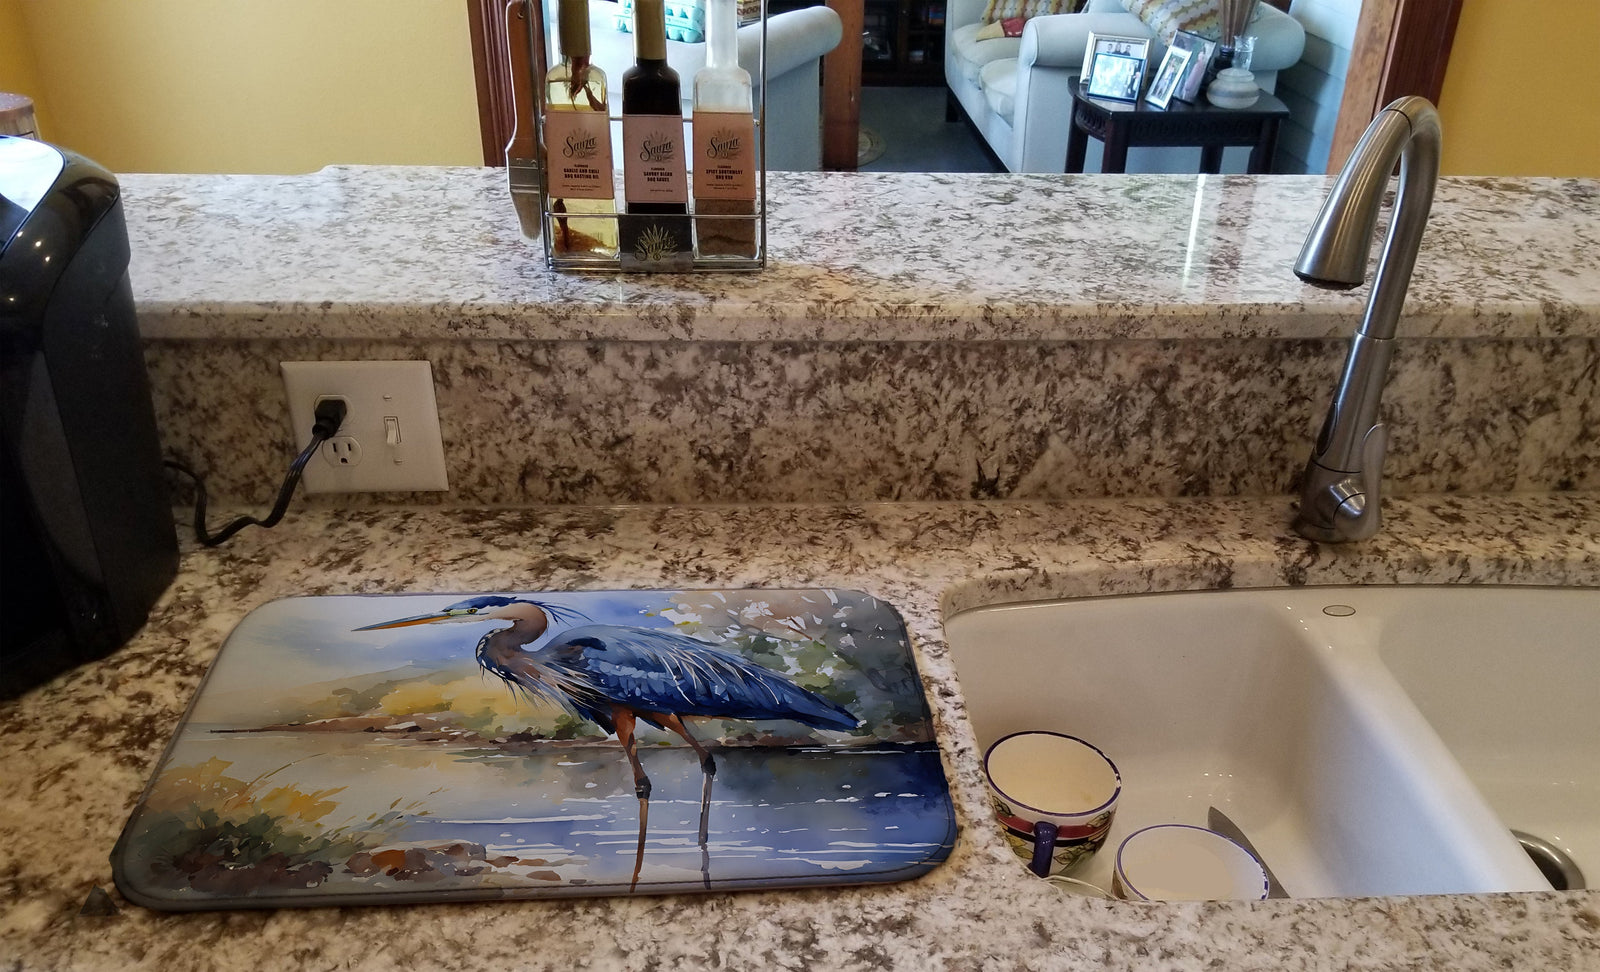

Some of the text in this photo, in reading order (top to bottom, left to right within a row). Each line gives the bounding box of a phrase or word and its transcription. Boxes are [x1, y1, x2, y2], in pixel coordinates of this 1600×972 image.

[563, 136, 597, 158] Sauza
[640, 140, 674, 161] Sauza
[707, 136, 740, 159] Sauza
